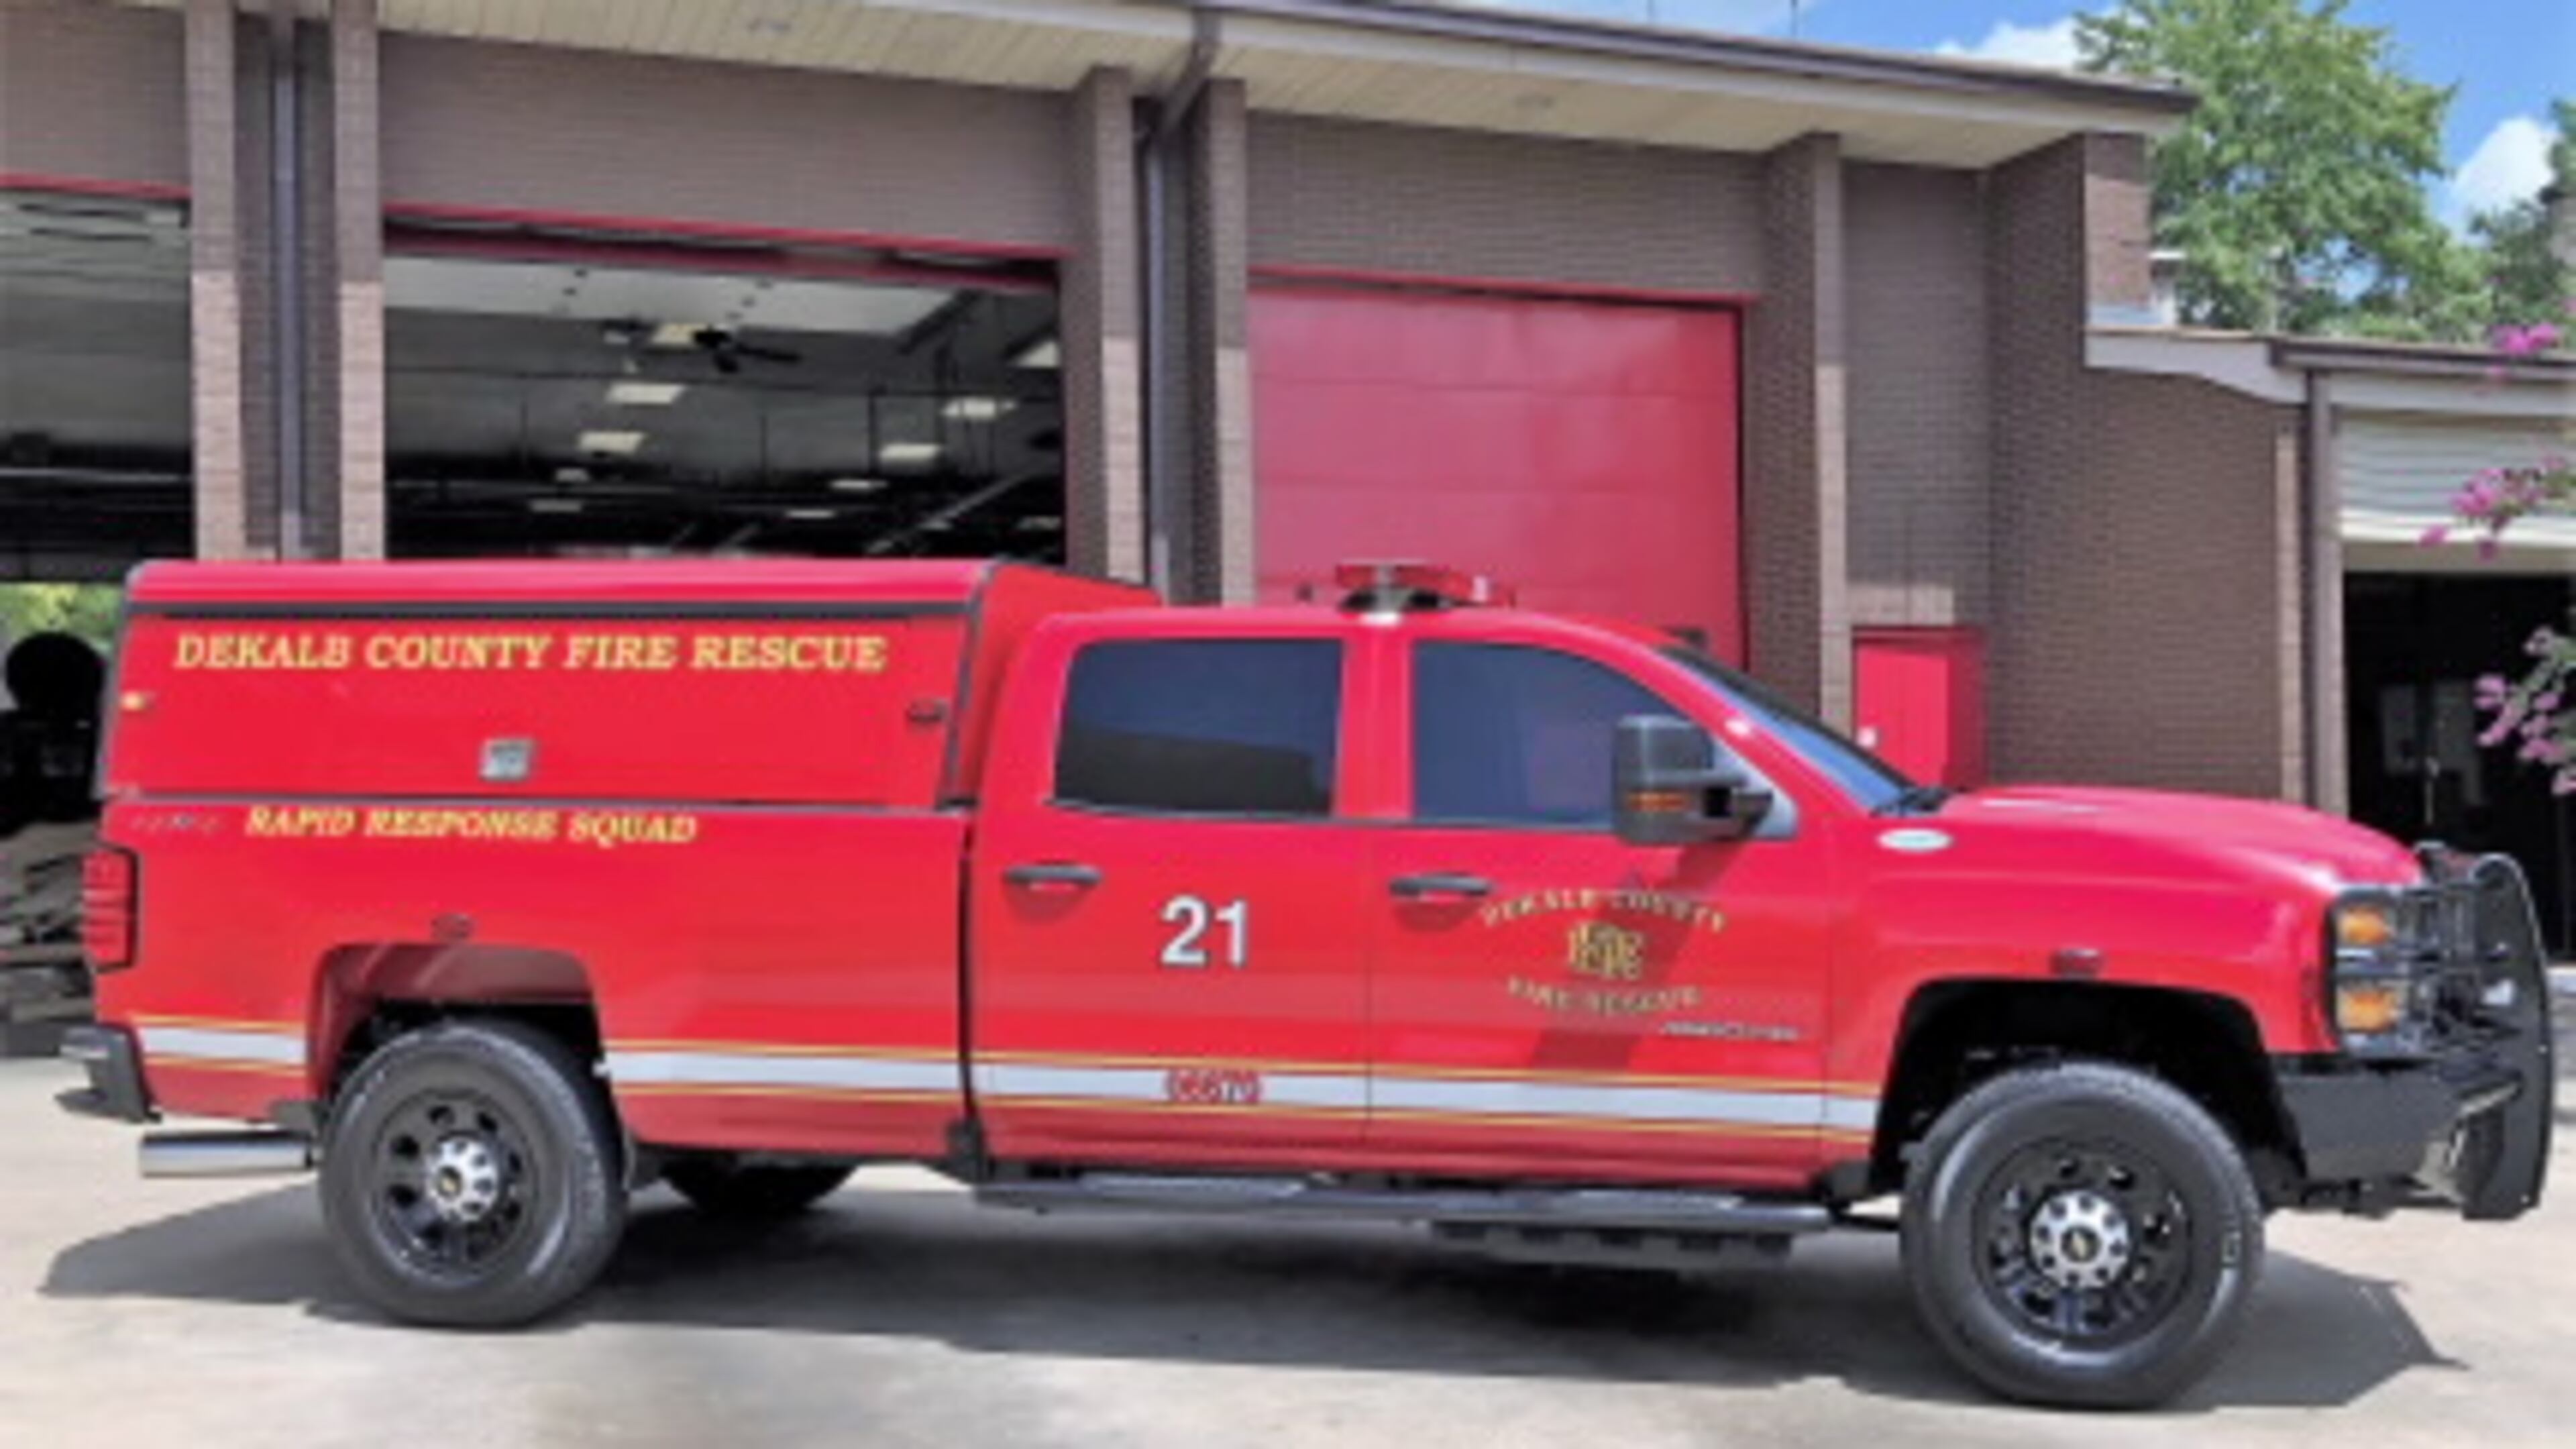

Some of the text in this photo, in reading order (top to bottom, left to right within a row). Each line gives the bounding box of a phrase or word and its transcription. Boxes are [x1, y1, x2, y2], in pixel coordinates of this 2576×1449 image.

[174, 634, 887, 671] DEKALB COUNTY FIRE RESCUE
[245, 805, 356, 837] RAPID
[364, 808, 559, 840] RESPONSE
[570, 812, 696, 848] SQUAD
[1161, 896, 1250, 969] 21
